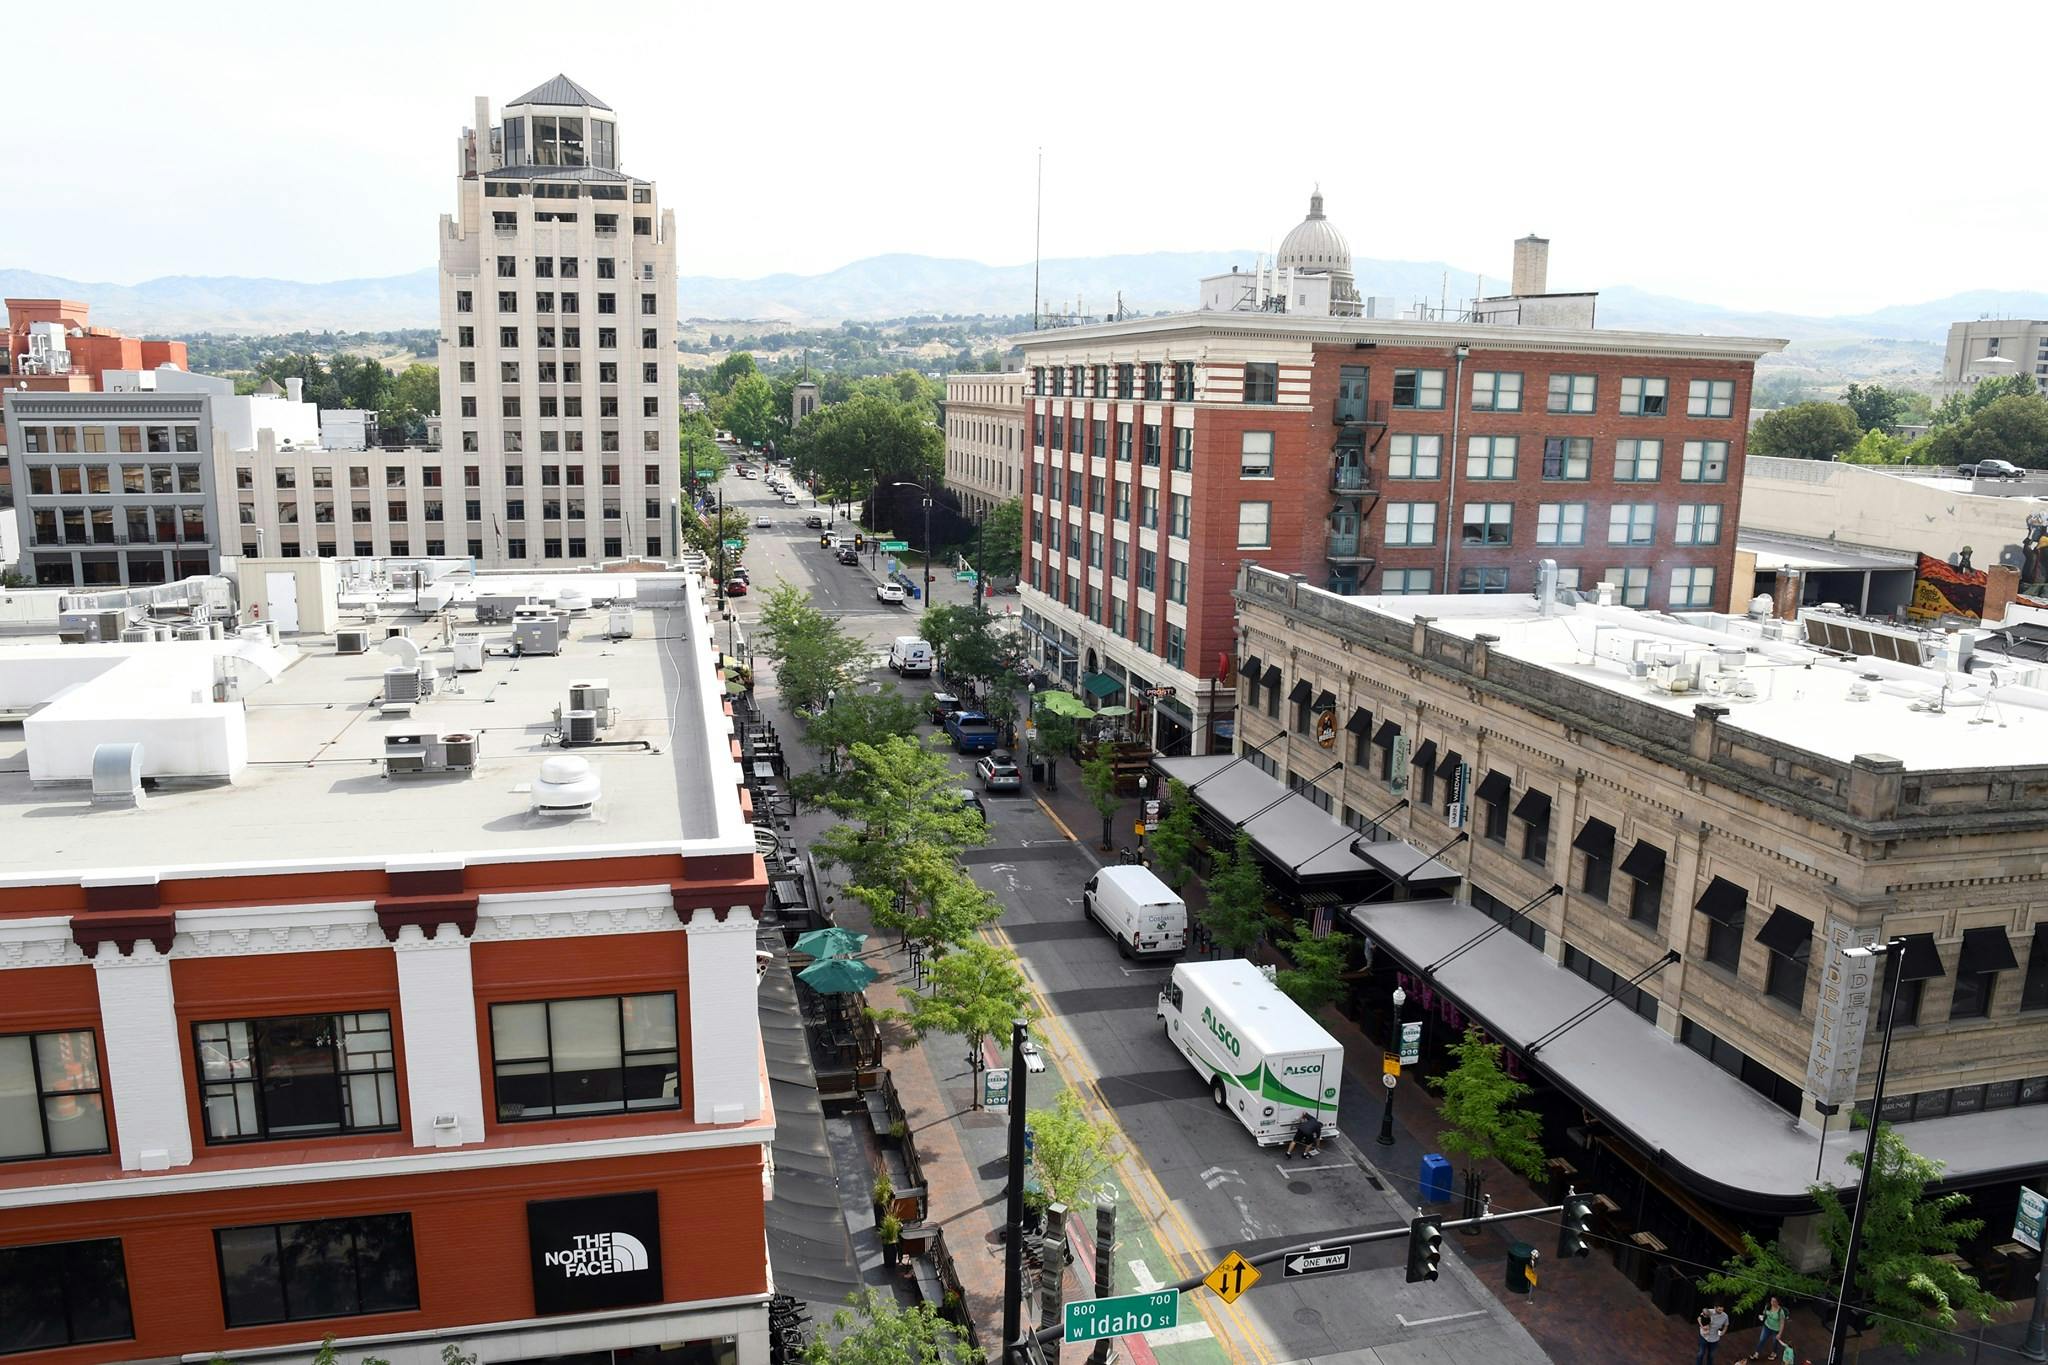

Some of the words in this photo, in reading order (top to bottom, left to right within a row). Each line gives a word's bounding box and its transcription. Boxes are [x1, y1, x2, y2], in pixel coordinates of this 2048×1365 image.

[1453, 766, 1462, 804] WARDWELL
[1813, 927, 1848, 1080] FIDELITY
[1201, 1006, 1240, 1057] ALSCO
[1284, 1065, 1321, 1075] ALSCO
[573, 1232, 611, 1249] THE
[545, 1246, 612, 1266] NORTH
[1303, 1258, 1320, 1267] ONE
[1325, 1255, 1342, 1264] WAY
[565, 1260, 613, 1278] FACE
[1073, 1304, 1096, 1316] 800
[1150, 1294, 1171, 1306] 700
[1073, 1327, 1083, 1338] W
[1090, 1312, 1152, 1336] Idaho
[1159, 1315, 1170, 1326] St
